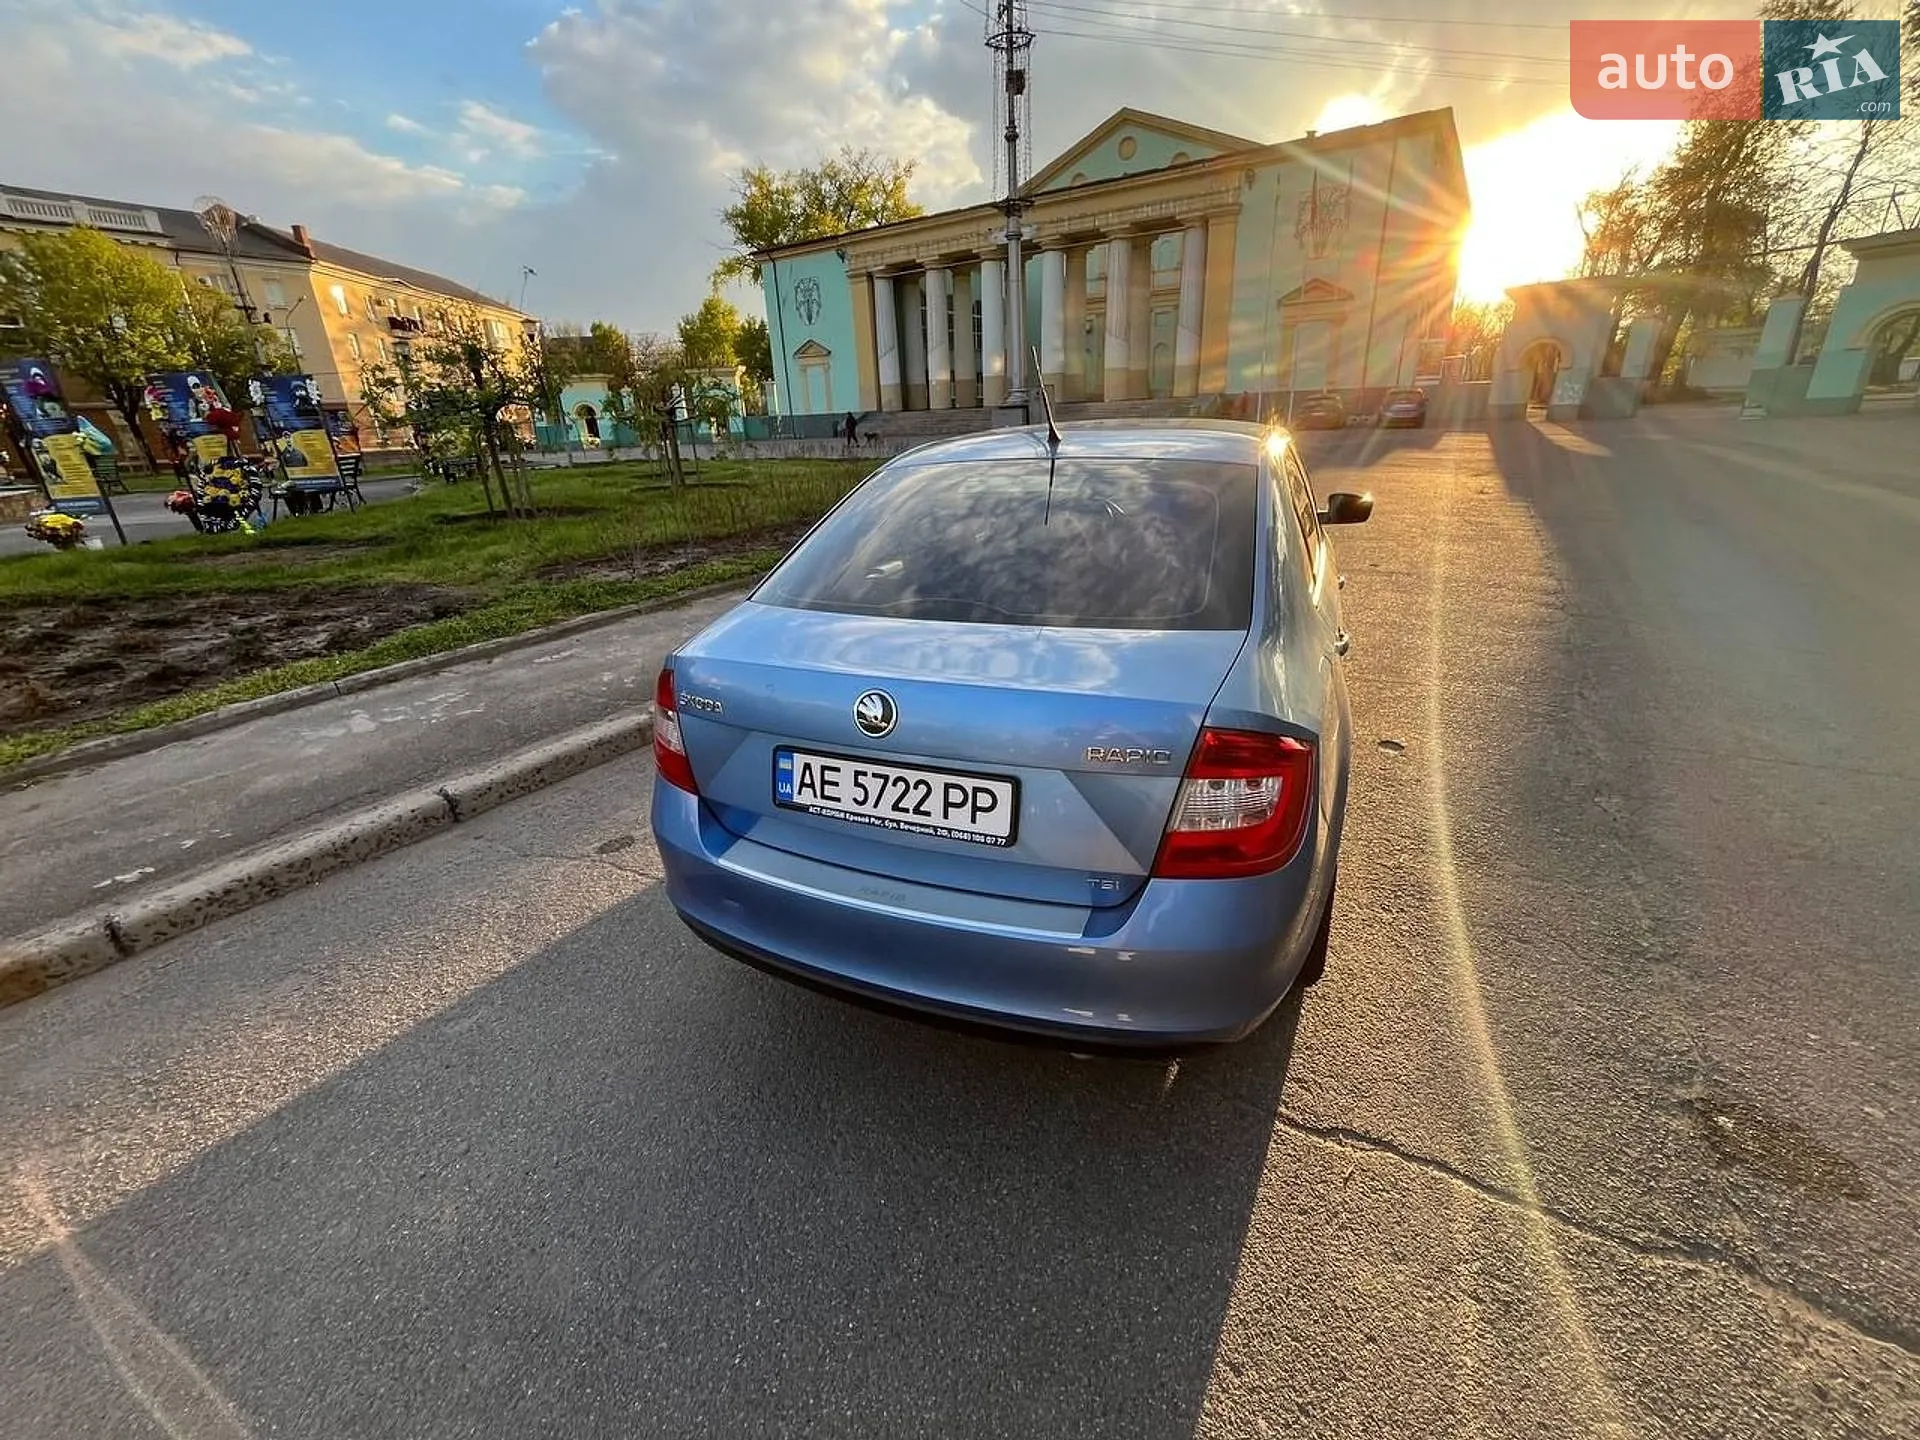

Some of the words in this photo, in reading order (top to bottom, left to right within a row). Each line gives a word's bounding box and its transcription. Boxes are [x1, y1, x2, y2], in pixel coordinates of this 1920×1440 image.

[1087, 746, 1172, 765] RAPID
[778, 781, 792, 795] UA
[797, 762, 841, 803] AE
[852, 770, 932, 817] 5722
[942, 782, 998, 824] PP
